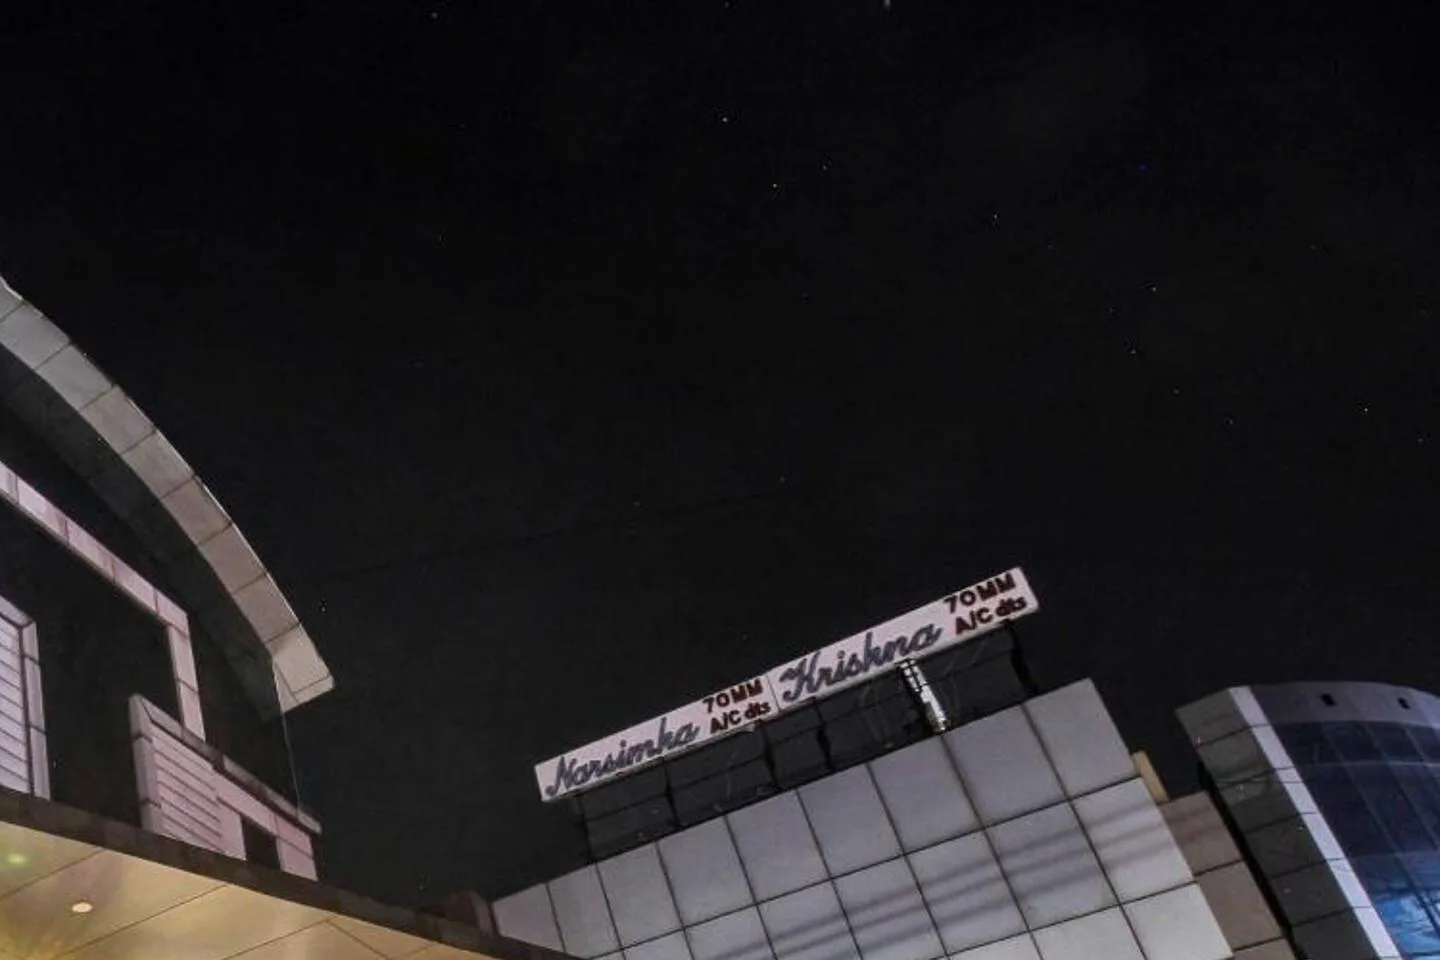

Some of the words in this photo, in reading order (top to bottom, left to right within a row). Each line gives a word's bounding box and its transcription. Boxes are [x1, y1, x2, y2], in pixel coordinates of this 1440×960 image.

[944, 572, 1016, 615] 70MM
[955, 606, 994, 636] A/C
[779, 623, 943, 702] Krishna
[703, 679, 764, 714] 70MM
[709, 710, 742, 735] A/C
